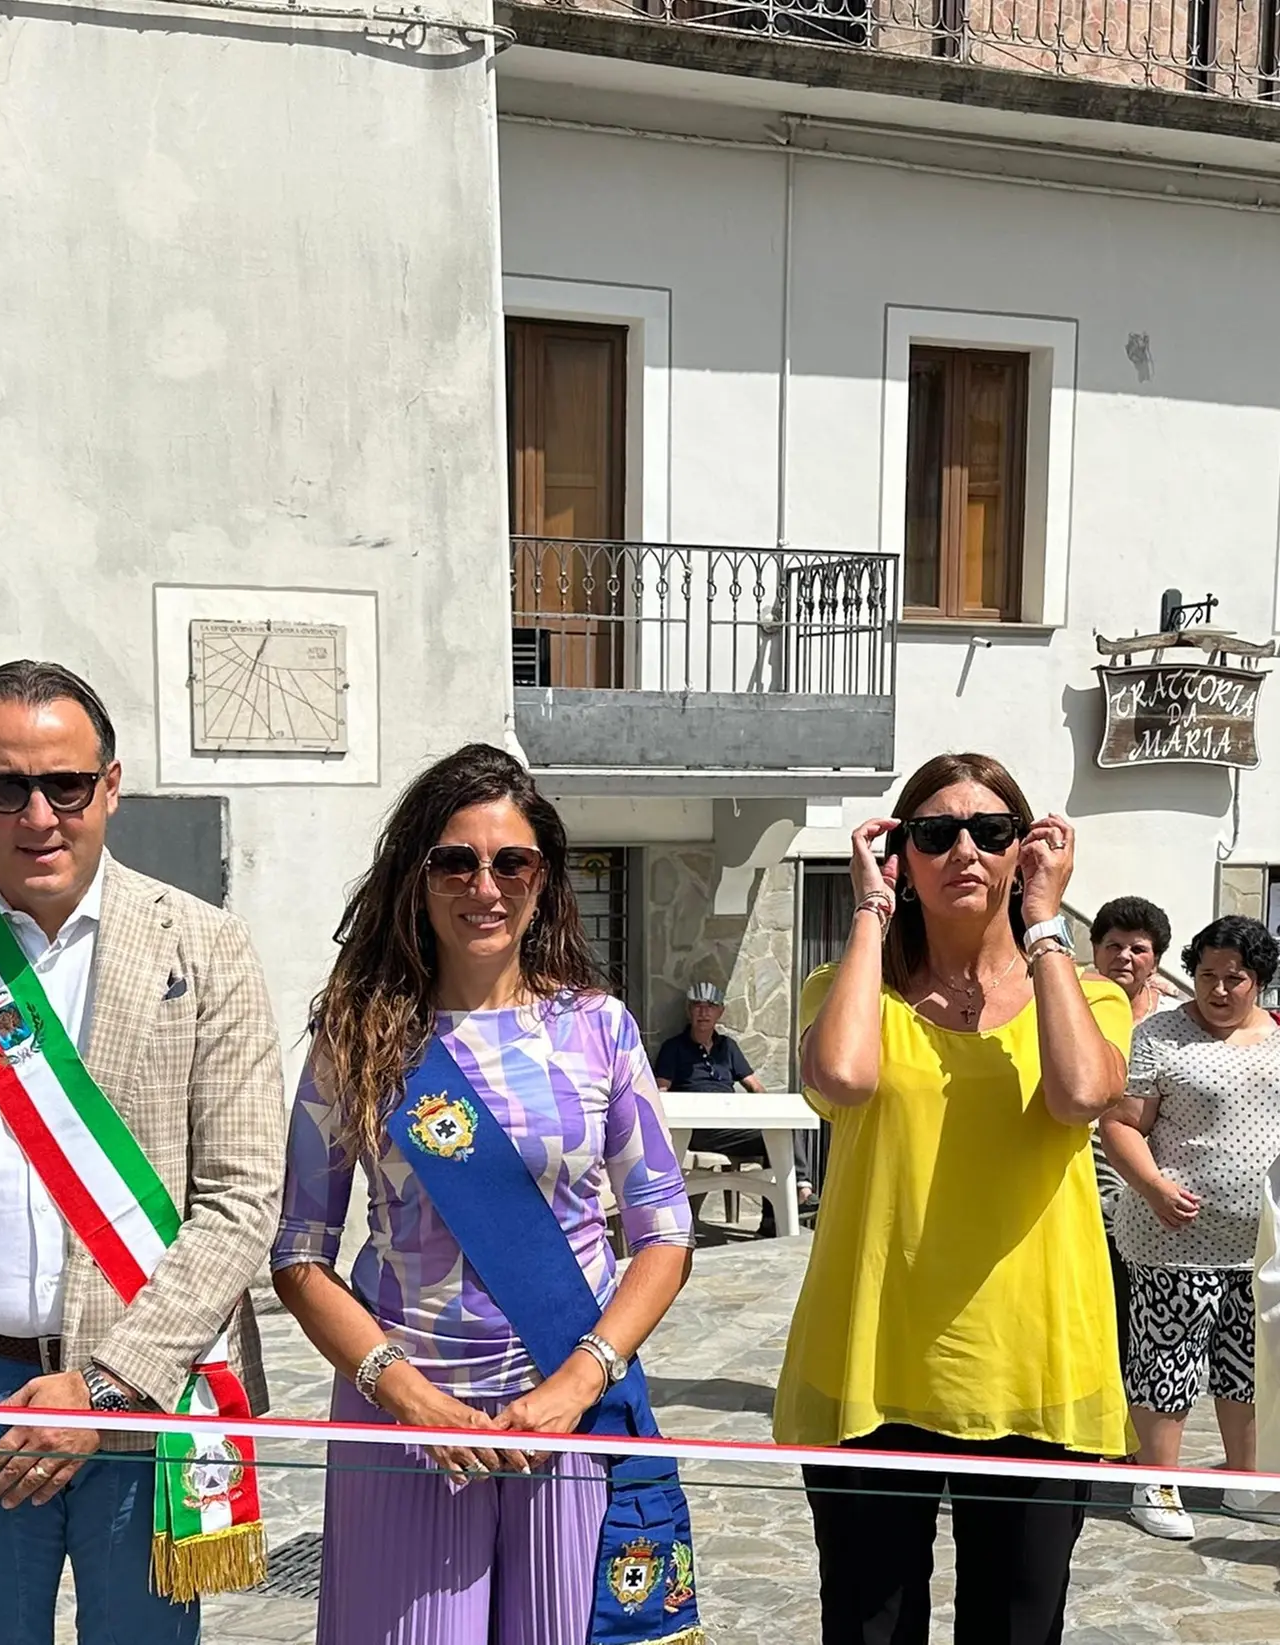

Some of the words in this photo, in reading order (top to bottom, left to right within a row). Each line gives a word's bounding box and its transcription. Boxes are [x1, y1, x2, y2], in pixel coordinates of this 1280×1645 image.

[1110, 669, 1256, 717] TRATTORIA
[1167, 702, 1197, 728] DA
[1129, 725, 1231, 761] MARIA
